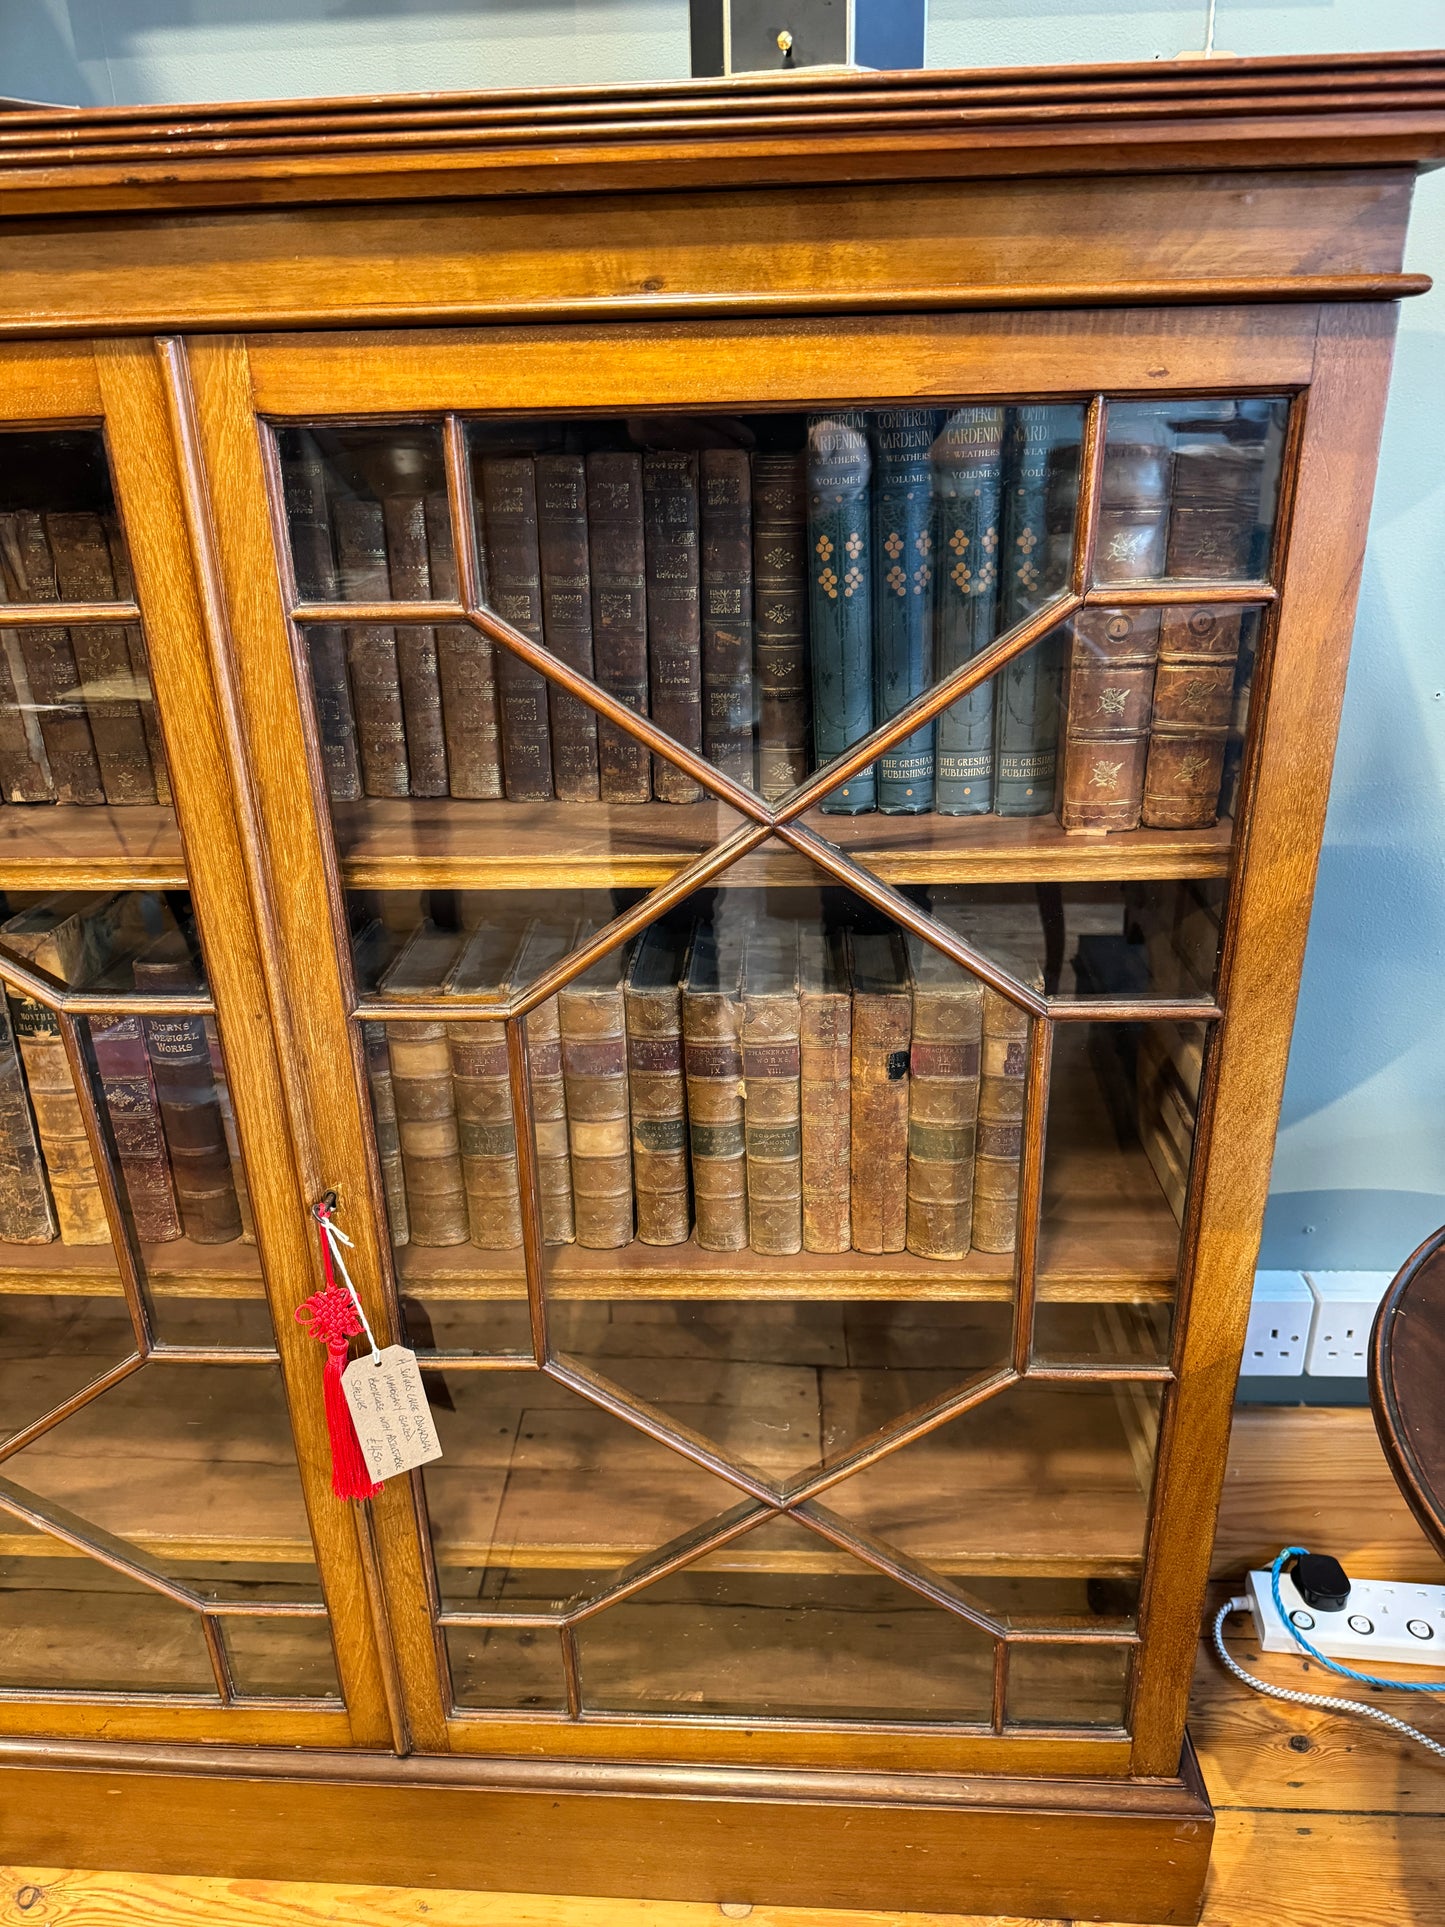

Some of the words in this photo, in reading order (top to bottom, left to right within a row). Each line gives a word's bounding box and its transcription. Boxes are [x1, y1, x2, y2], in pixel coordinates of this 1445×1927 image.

[877, 410, 936, 430] COMMERCIA
[946, 407, 1004, 424] COMMERCIA
[879, 430, 935, 449] GARDENIN
[946, 426, 1002, 445] GARDENIN
[885, 452, 932, 463] WEATHERS
[953, 448, 1000, 458] WEATHERS
[882, 759, 897, 769] THE
[940, 757, 955, 767] THE
[1001, 758, 1018, 767] THE
[882, 768, 926, 779] PUBLISHING
[940, 767, 985, 778] PUBLISHING
[1001, 768, 1048, 778] PUBLISHING
[18, 1023, 60, 1031] MAGAZIN
[150, 1020, 193, 1031] BURNS'
[156, 1042, 193, 1053] WORKS
[398, 1414, 416, 1442] GLAZED
